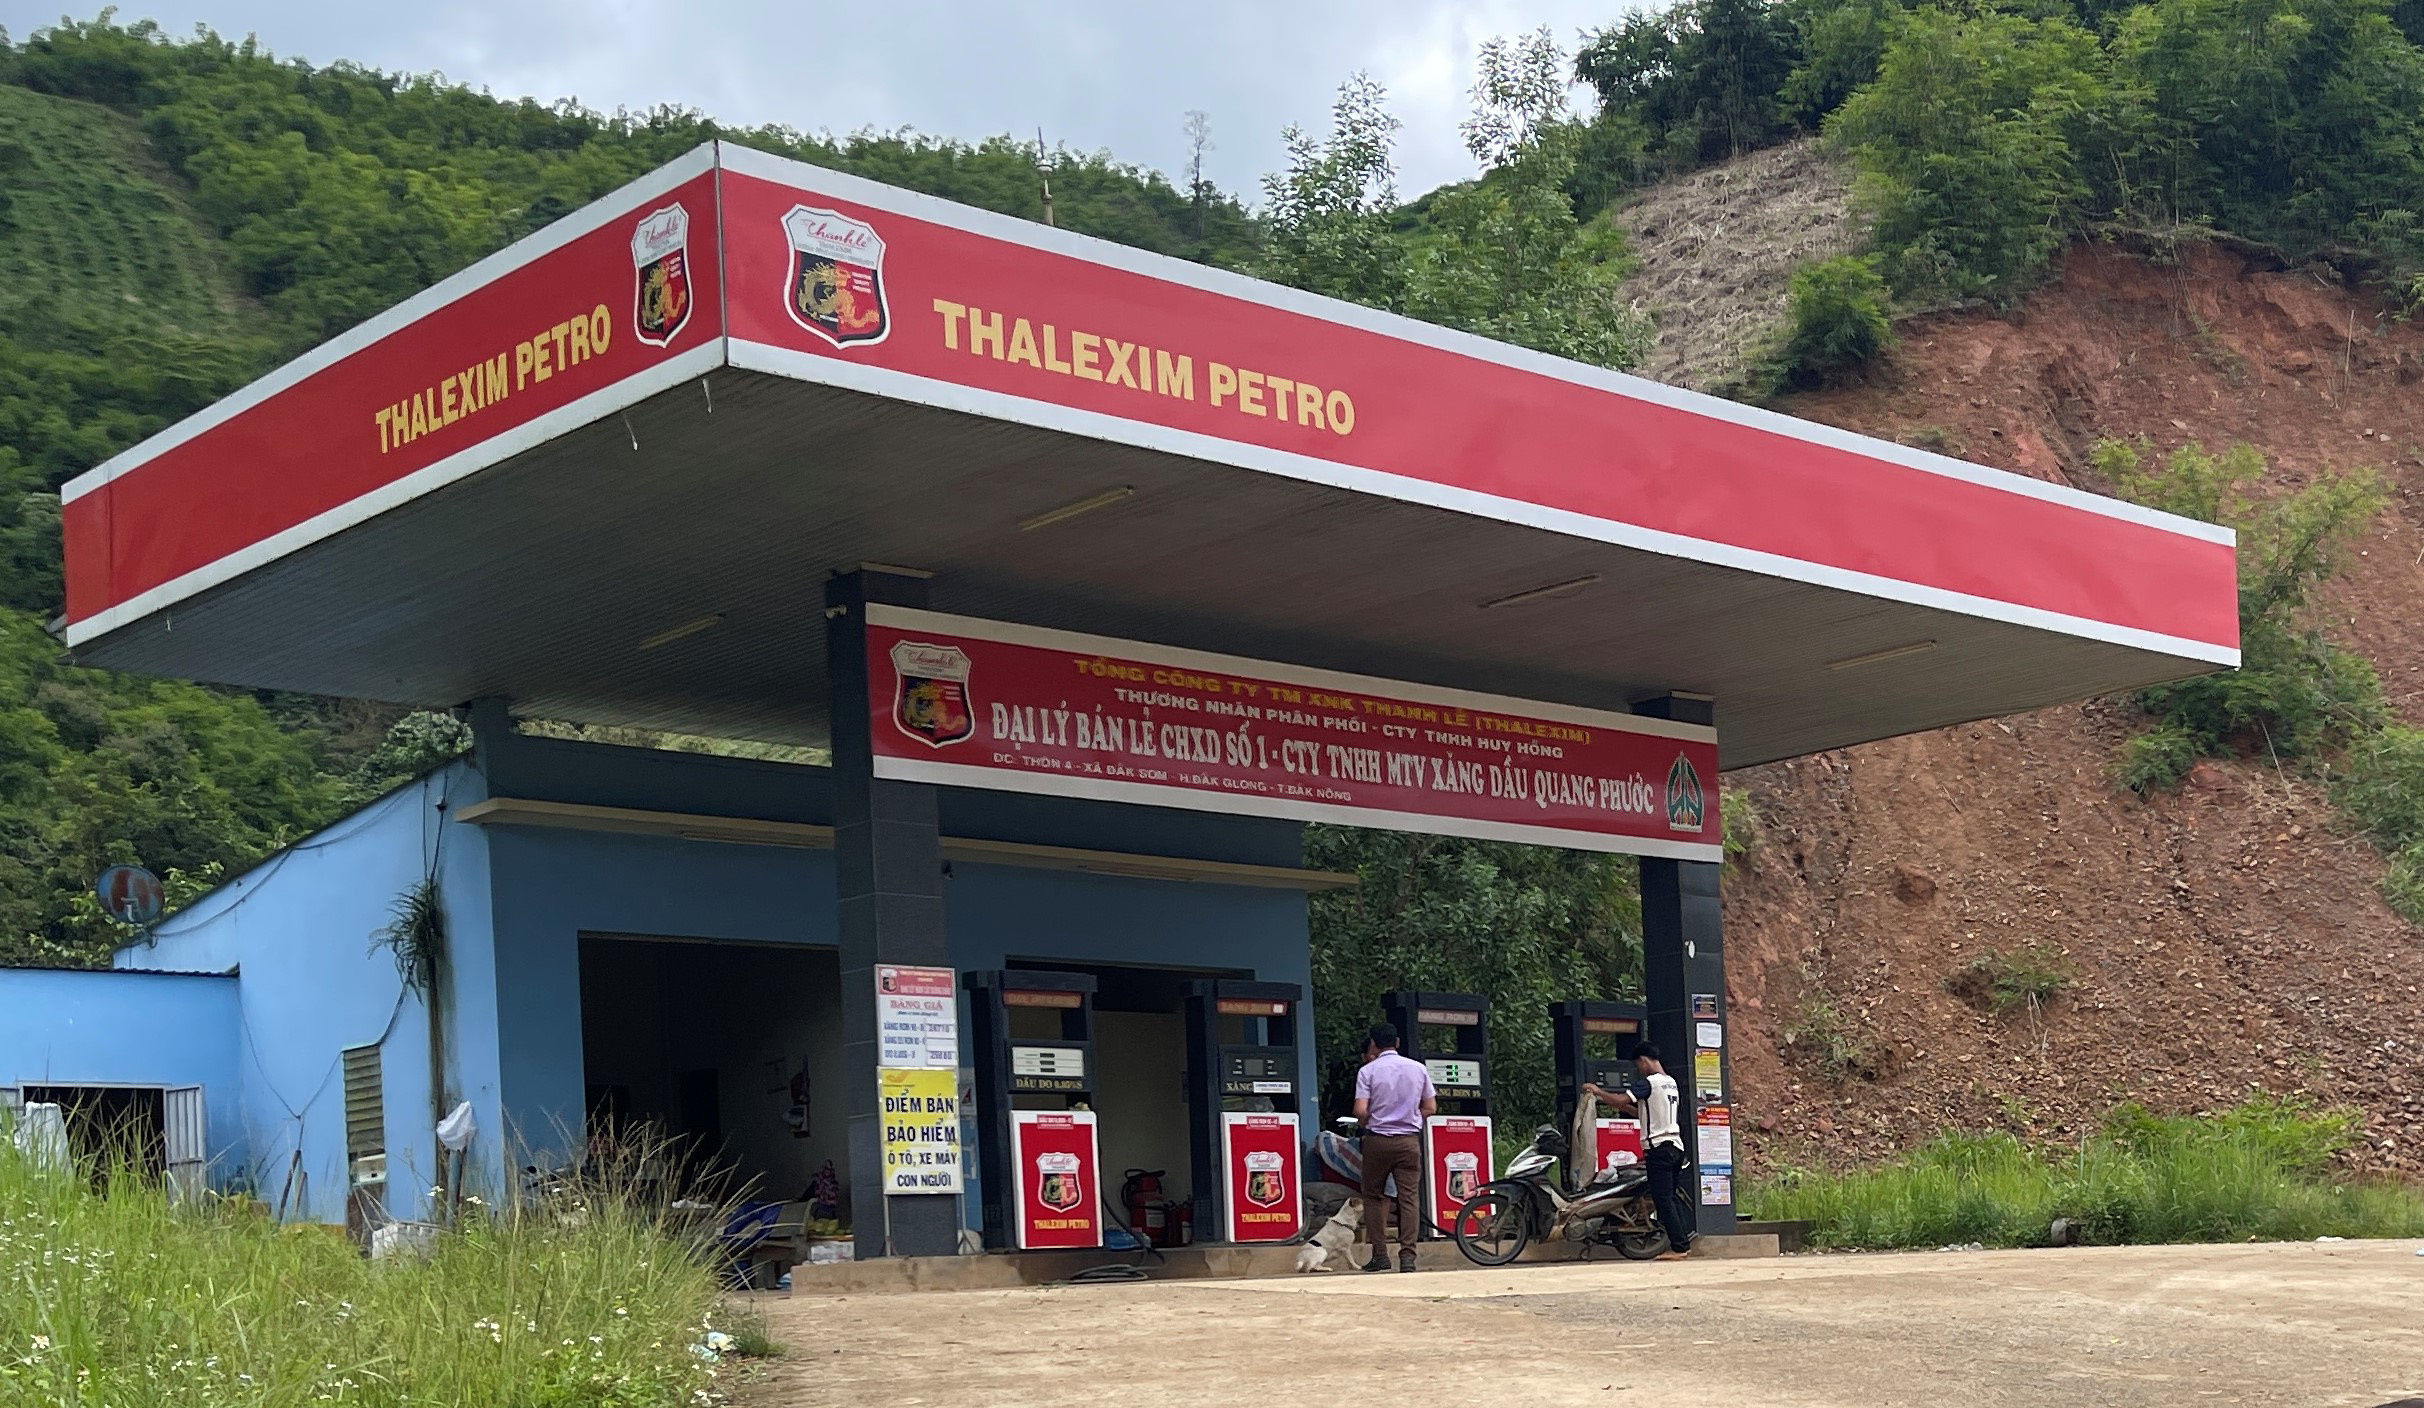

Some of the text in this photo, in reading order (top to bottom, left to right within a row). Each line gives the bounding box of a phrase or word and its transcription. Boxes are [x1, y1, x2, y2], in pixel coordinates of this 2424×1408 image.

[375, 304, 612, 454] THALEXIM PETRO
[933, 299, 1356, 436] THALEXIM PETRO
[1074, 656, 1146, 682] TỔNG
[1153, 669, 1222, 693] CÔNG
[1227, 680, 1261, 698] TY
[1266, 687, 1301, 705] TM
[1308, 690, 1355, 711] XNK
[1361, 699, 1437, 723] THANH
[1114, 687, 1200, 711] THƯƠNG
[1205, 701, 1261, 721] NHÂN
[1266, 708, 1318, 728] PHÂN
[1323, 714, 1367, 733] PHỐI
[1382, 725, 1418, 740] CTY
[1424, 729, 1473, 748] TNHH
[1477, 736, 1513, 753] HUY
[991, 702, 1036, 750] ĐẠI
[1039, 700, 1070, 747] LÝ
[1075, 703, 1124, 753] BÁN
[1128, 706, 1157, 757] LẺ
[1160, 723, 1221, 765] CHXD
[1225, 718, 1252, 768] SỐ
[1256, 734, 1270, 770] 1
[1282, 738, 1321, 776] CTY
[1326, 745, 1383, 784] TNHH
[1387, 752, 1427, 789] MTV
[1432, 751, 1485, 797] XĂNG
[1489, 755, 1529, 801] DẦU
[1533, 770, 1596, 809] QUANG
[1600, 772, 1655, 815] PHƯỚC
[1022, 754, 1061, 769] THÔN
[1222, 778, 1268, 792] GLONG
[1316, 787, 1352, 802] NÔNG
[889, 998, 943, 1011] BẢNG GIÁ
[886, 1088, 954, 1114] ĐIỂM BÁN
[887, 1117, 956, 1143] BẢO HIỂM
[888, 1149, 896, 1165] Ô
[919, 1152, 932, 1165] XE
[935, 1149, 958, 1165] MÁY
[897, 1170, 952, 1187] CON NGƯỜI
